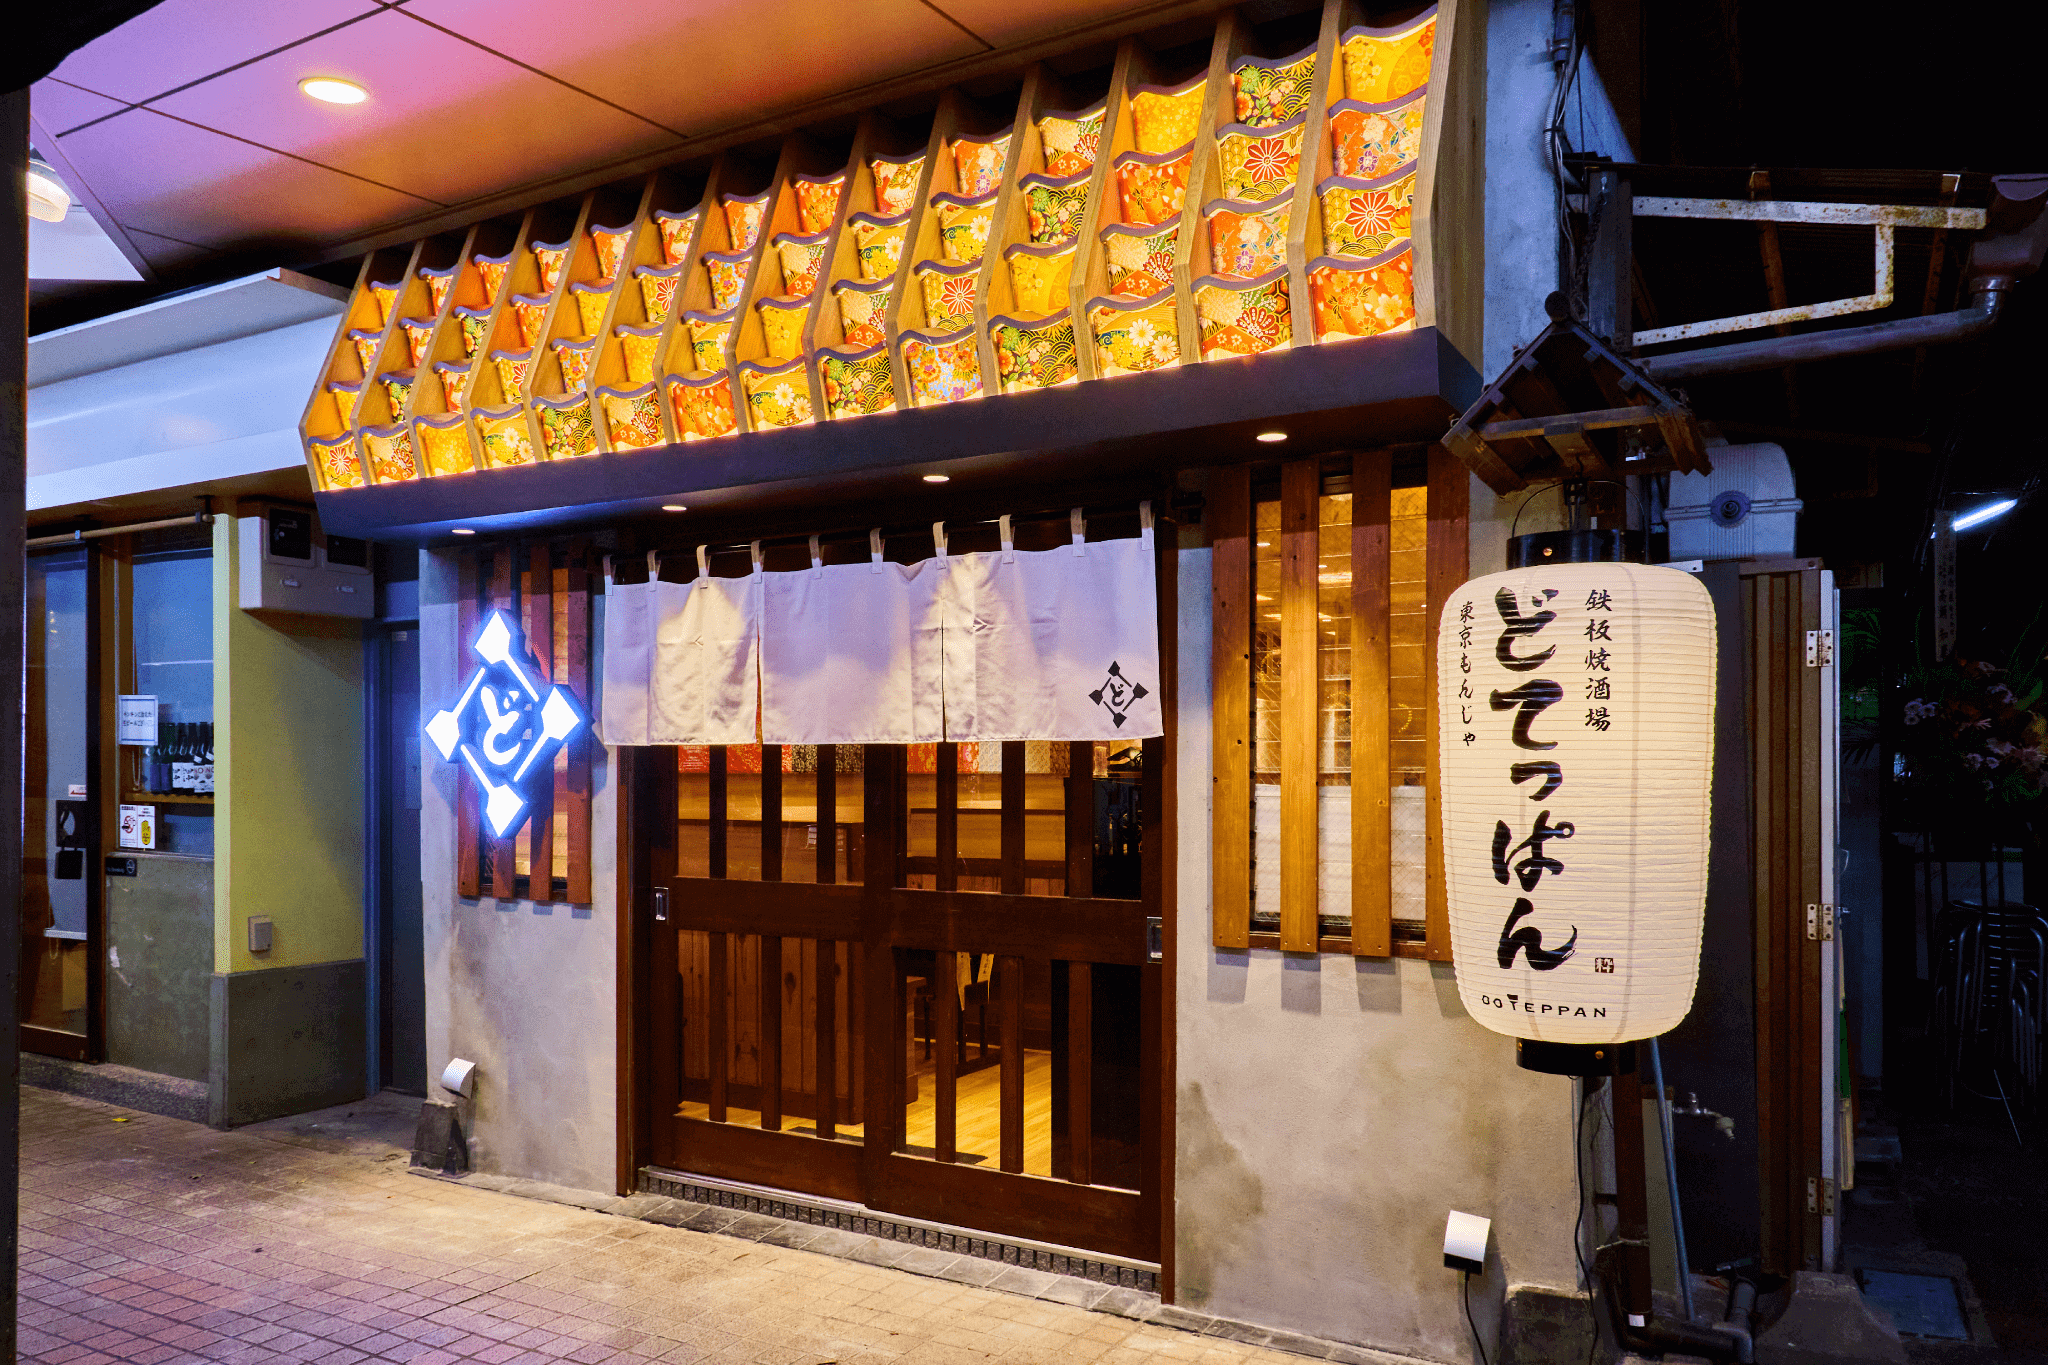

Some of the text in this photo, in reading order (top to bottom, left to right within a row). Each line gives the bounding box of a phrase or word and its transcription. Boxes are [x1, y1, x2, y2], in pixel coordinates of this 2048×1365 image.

[480, 686, 520, 766] ど
[1458, 600, 1476, 747] 東京もんじゃ
[1584, 589, 1613, 732] 鉄板焼酒場
[1488, 586, 1578, 972] どてっぱん
